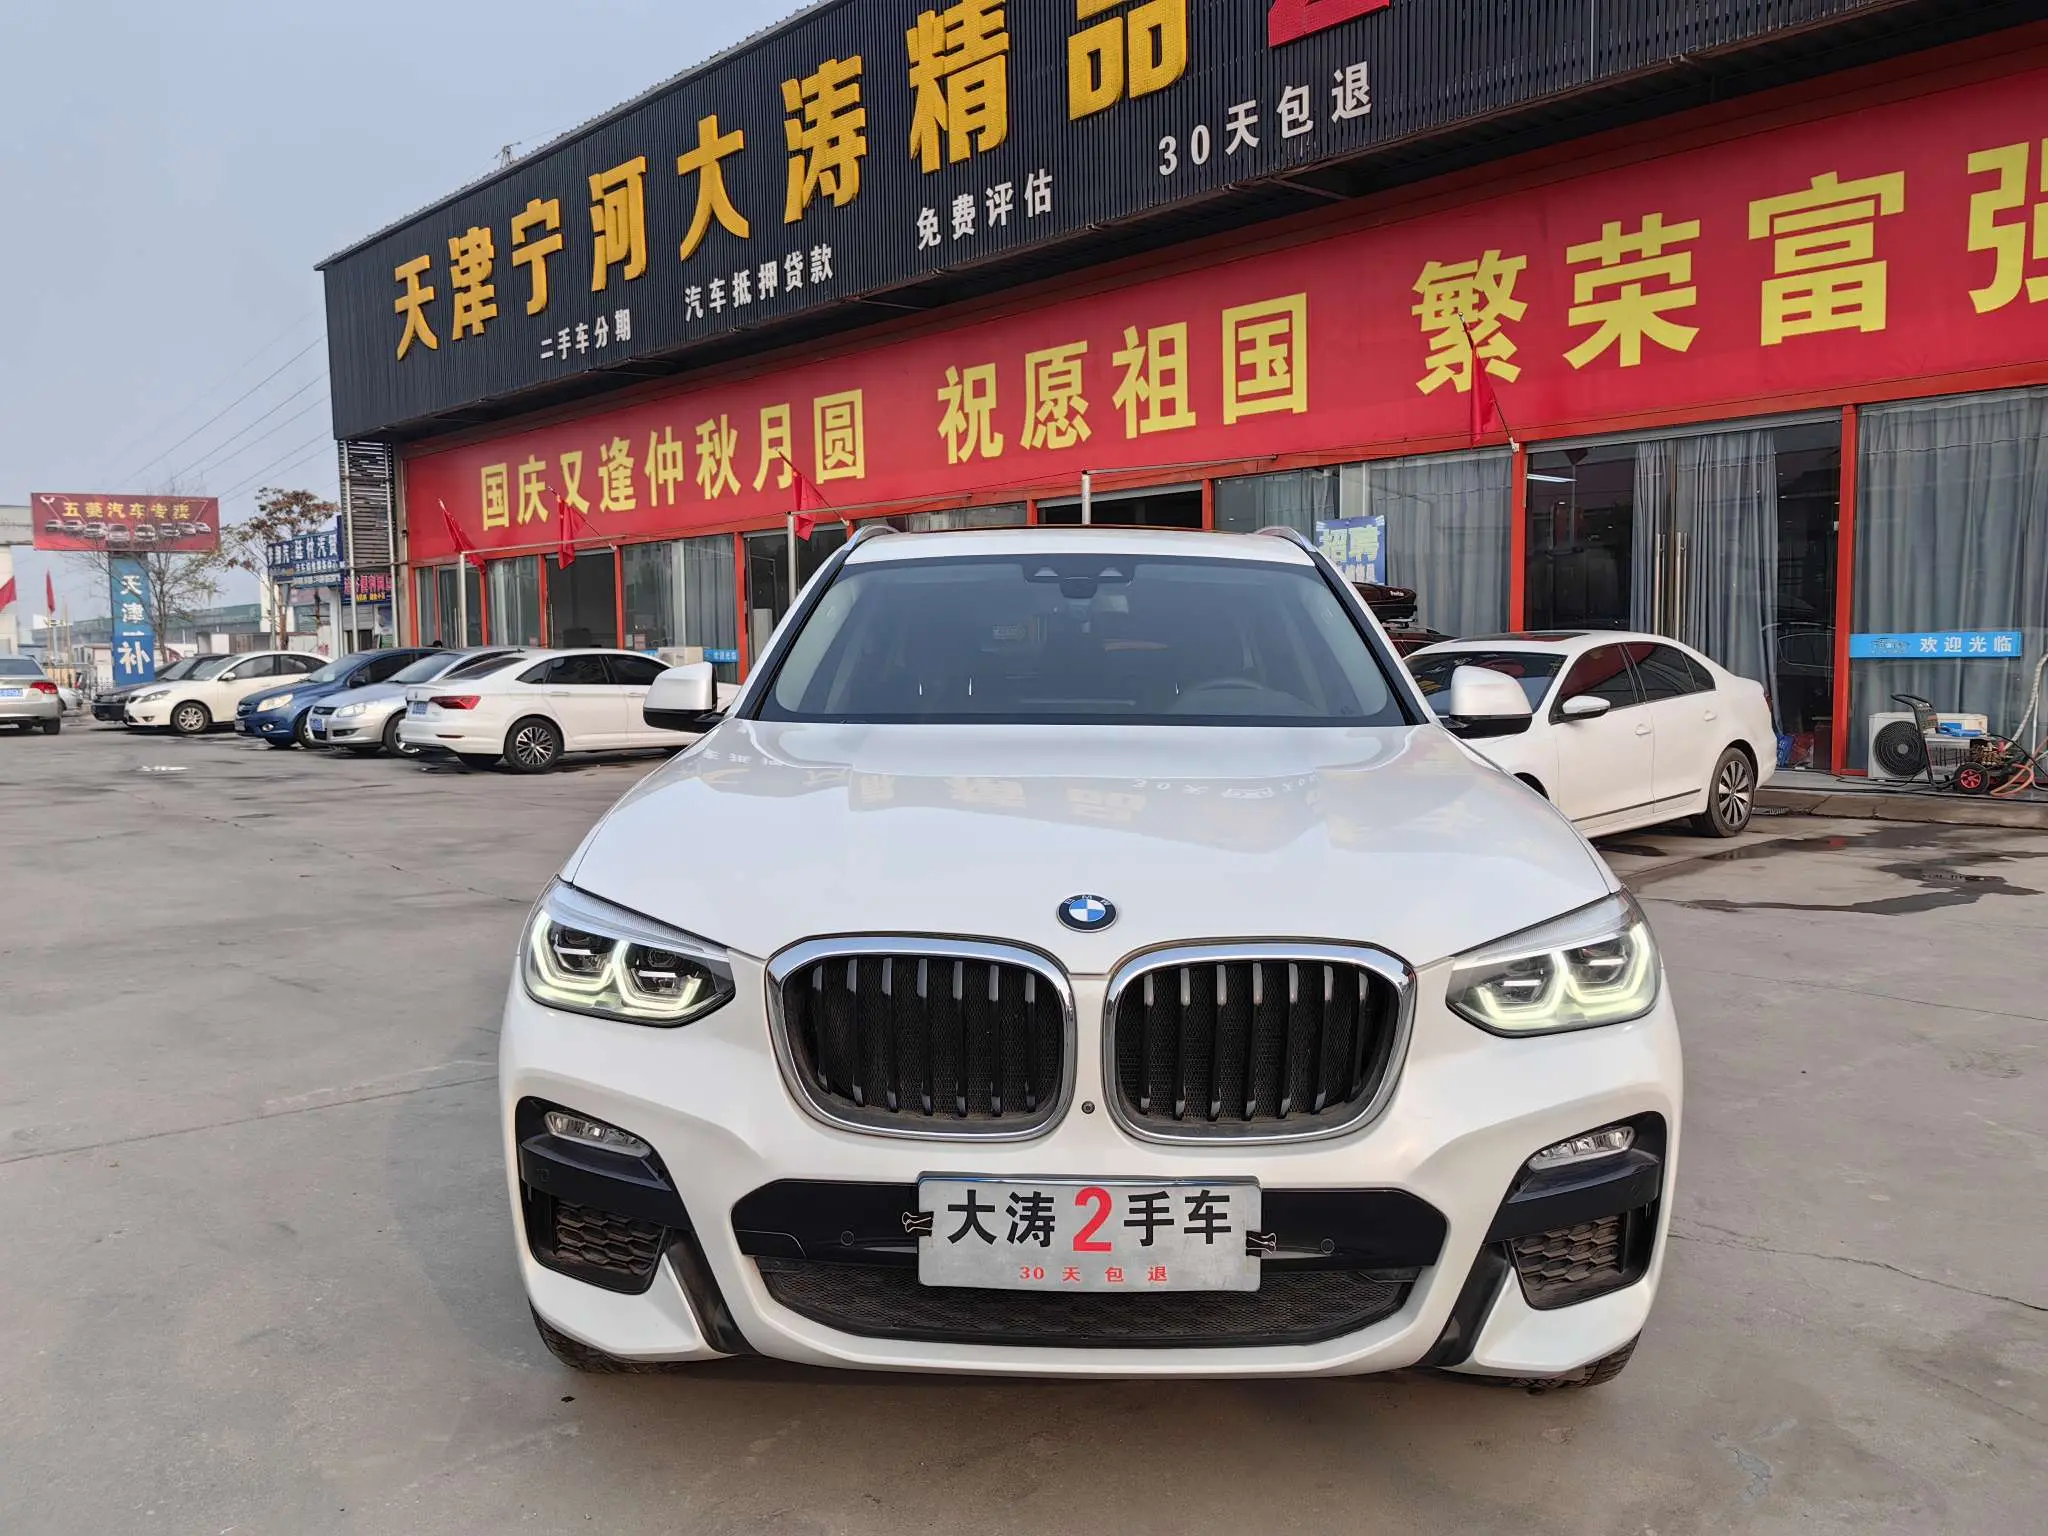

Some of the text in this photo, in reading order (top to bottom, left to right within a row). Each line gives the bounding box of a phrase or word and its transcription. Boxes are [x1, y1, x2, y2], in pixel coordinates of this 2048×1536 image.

[540, 61, 1372, 360] 二手车分期 汽车抵押贷款 免费评估 30天包退
[481, 389, 865, 530] 国庆又逢仲秋月圆
[938, 293, 1308, 465] 祝愿祖国
[1919, 636, 2013, 653] 欢迎光临
[946, 1186, 1233, 1253] 大涛2手车
[1019, 1266, 1168, 1282] 30天包退
